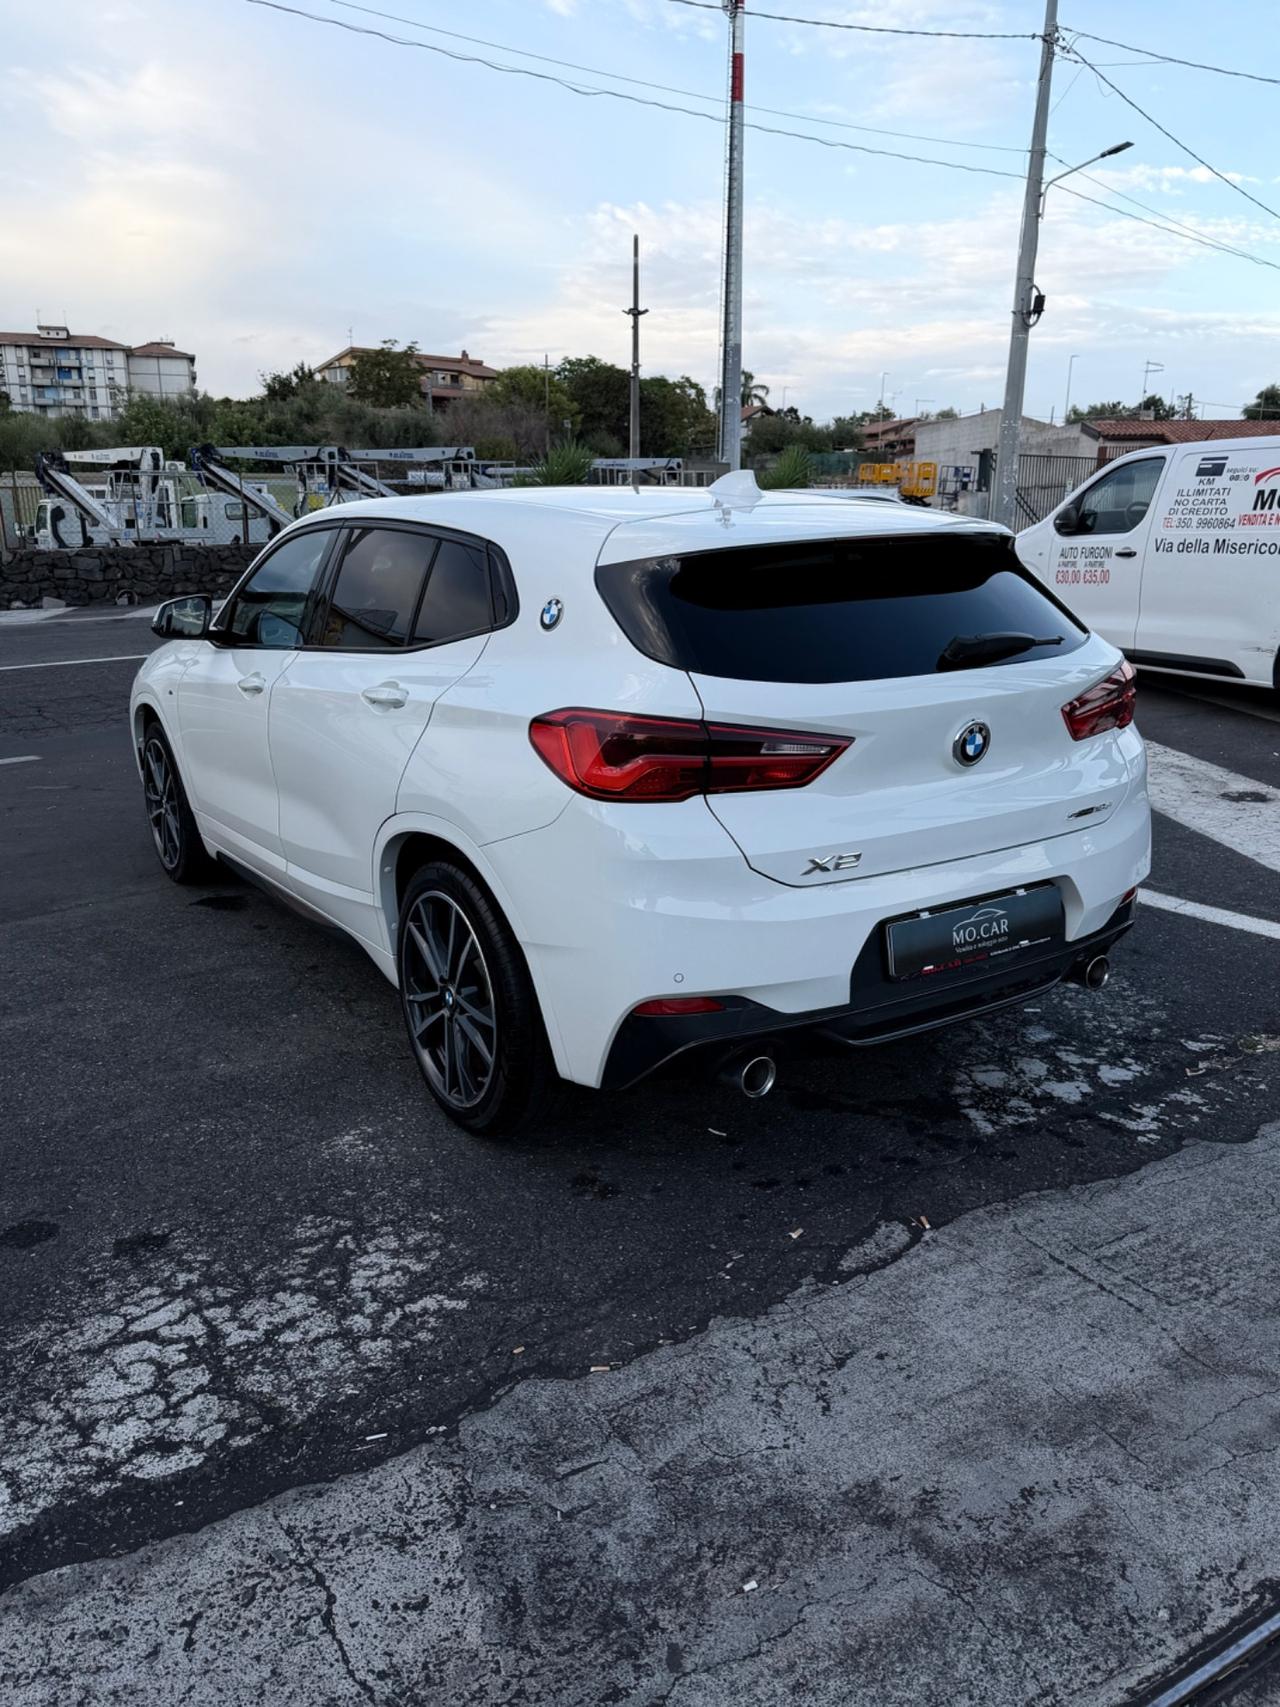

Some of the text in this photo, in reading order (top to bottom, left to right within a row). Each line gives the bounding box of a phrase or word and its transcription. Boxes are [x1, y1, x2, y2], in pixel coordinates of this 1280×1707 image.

[1198, 478, 1215, 486] KM
[1176, 487, 1231, 497] ILLIMITATI
[1174, 498, 1227, 506] NO CARTA
[1252, 489, 1280, 511] M
[1168, 507, 1228, 516] DI CREDITO
[1196, 518, 1236, 529] 9960864
[1238, 514, 1266, 526] VENDITA
[1268, 513, 1275, 526] E
[1059, 546, 1113, 559] AUTO FURGONI
[1154, 537, 1280, 555] Via della Miserico
[1055, 569, 1110, 586] €30,00 €35,00
[800, 851, 862, 876] X2
[952, 918, 1009, 945] MO.CAR
